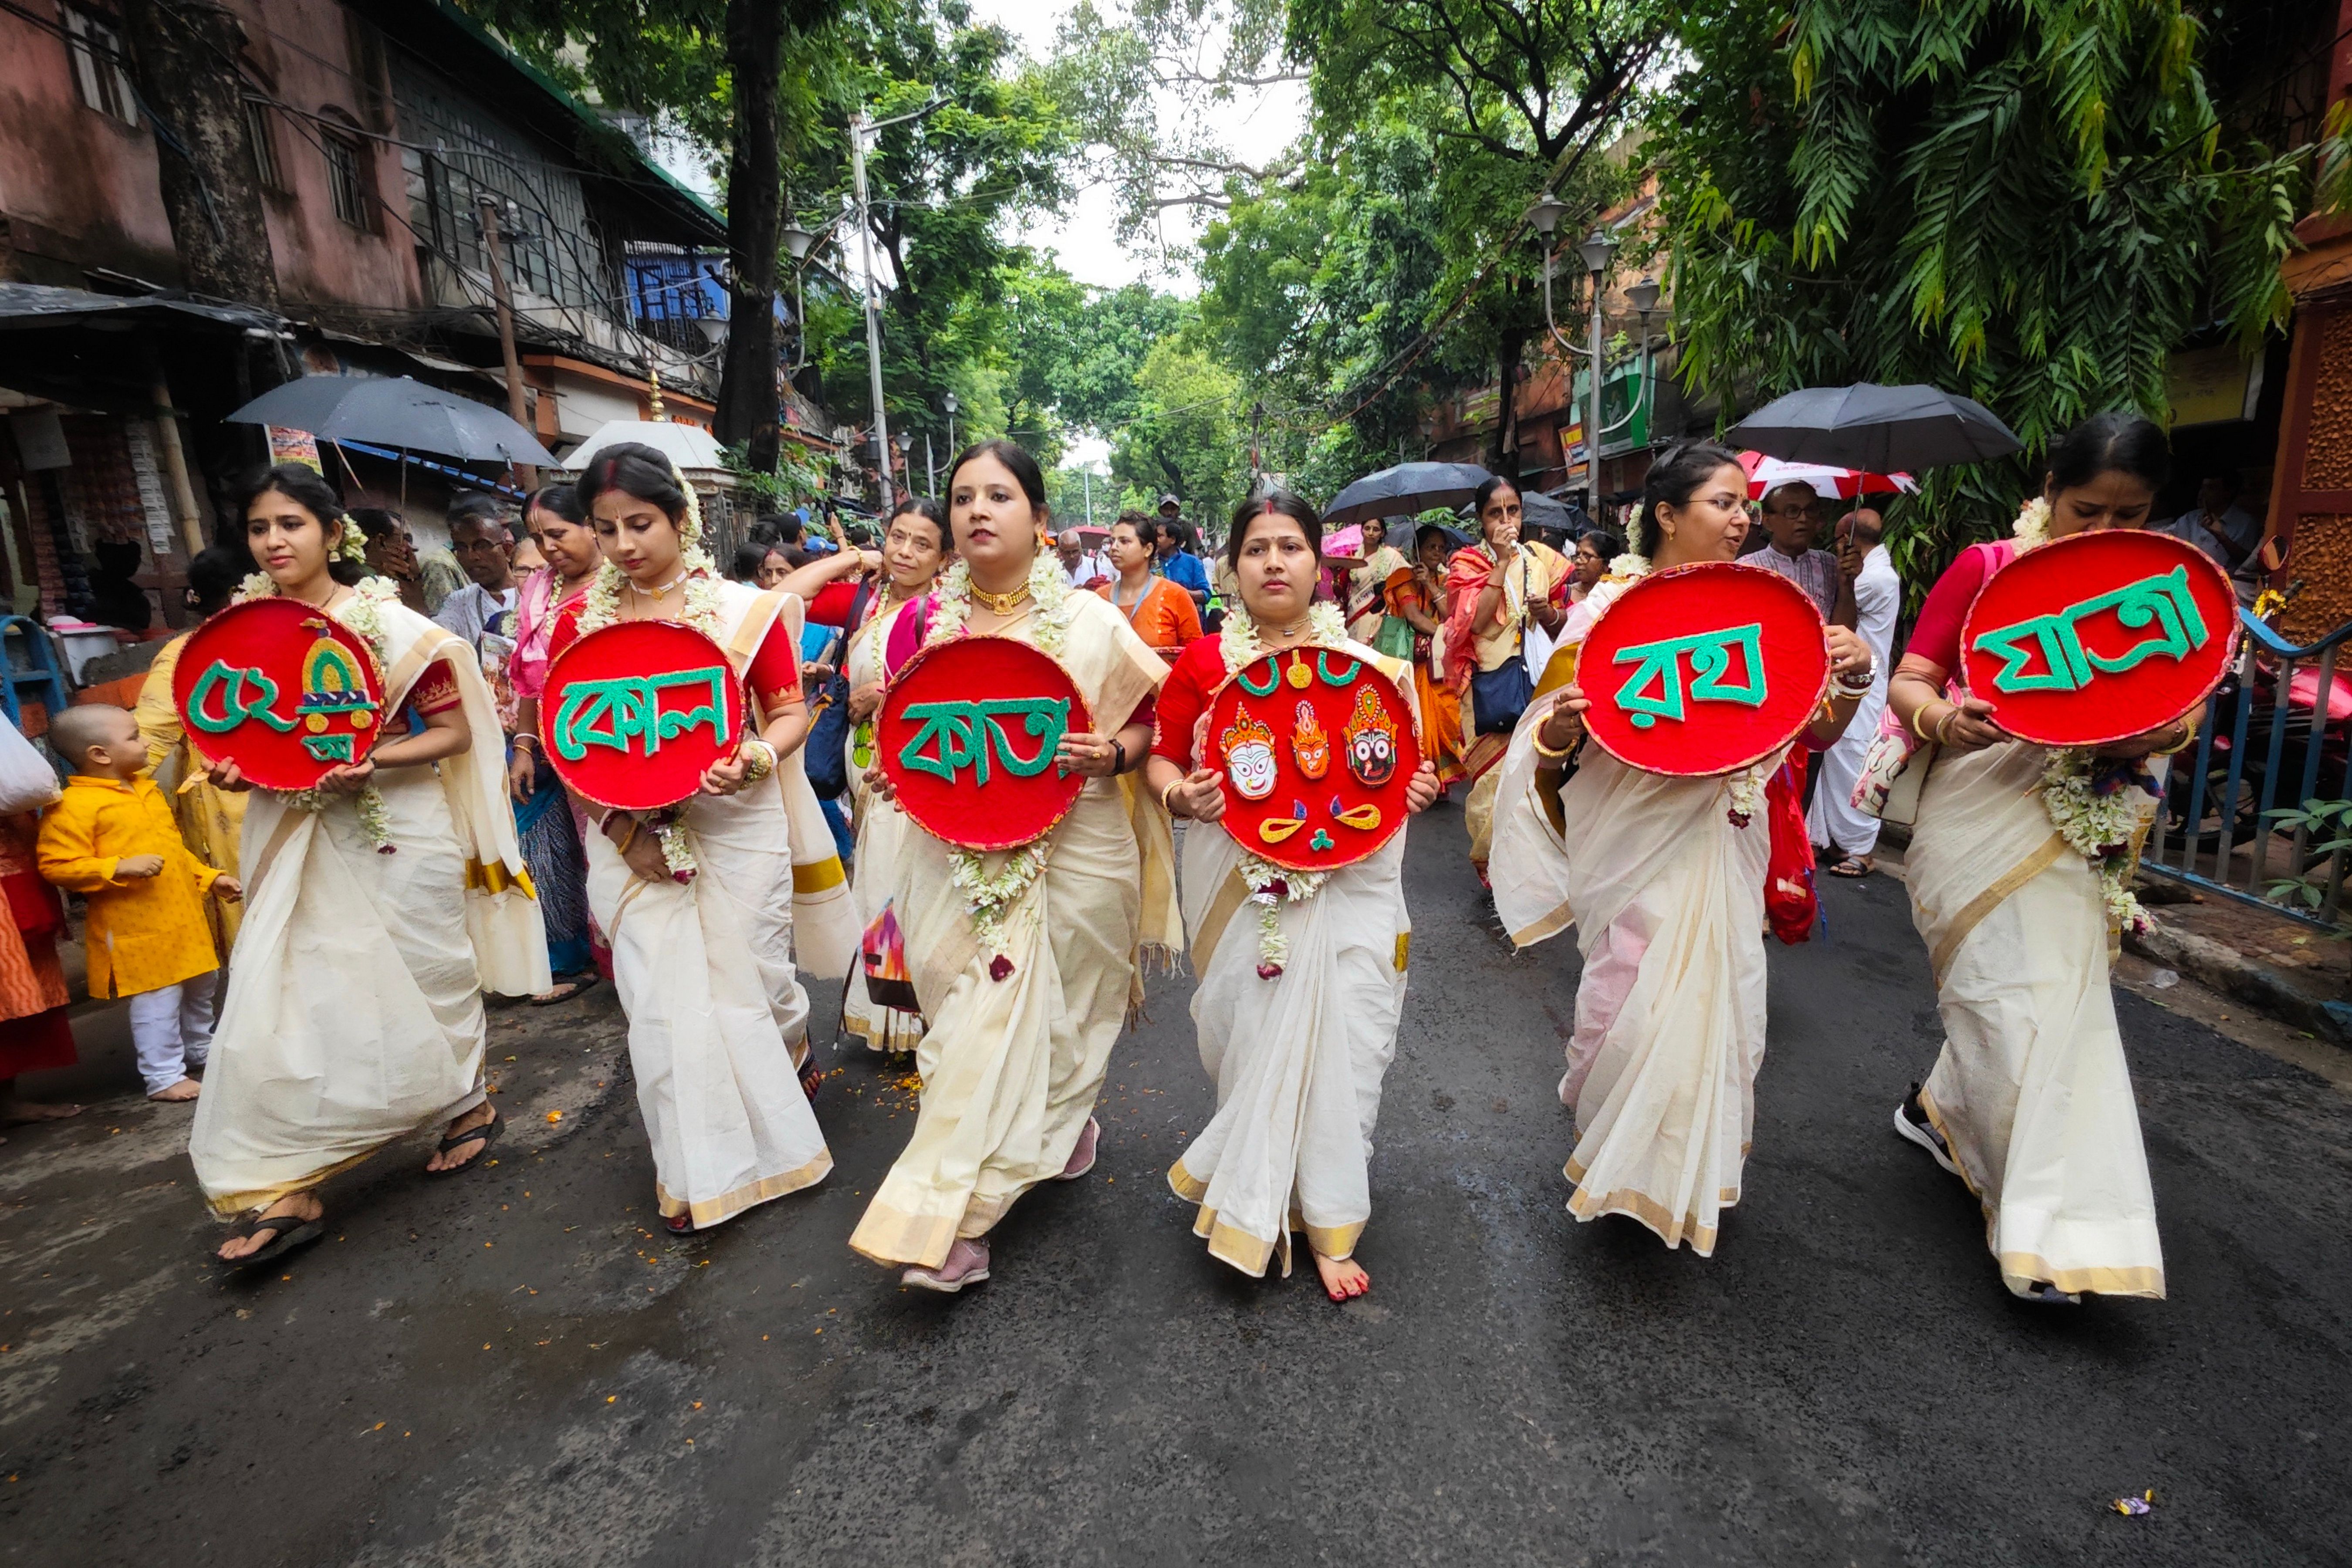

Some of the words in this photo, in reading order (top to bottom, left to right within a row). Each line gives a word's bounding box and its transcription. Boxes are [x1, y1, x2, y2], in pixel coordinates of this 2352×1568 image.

[1613, 623, 1767, 728] রথ
[1973, 564, 2209, 693] যাত্রা
[187, 659, 301, 732] ৫২
[554, 666, 728, 760] কোল
[898, 697, 1070, 787] কাতা
